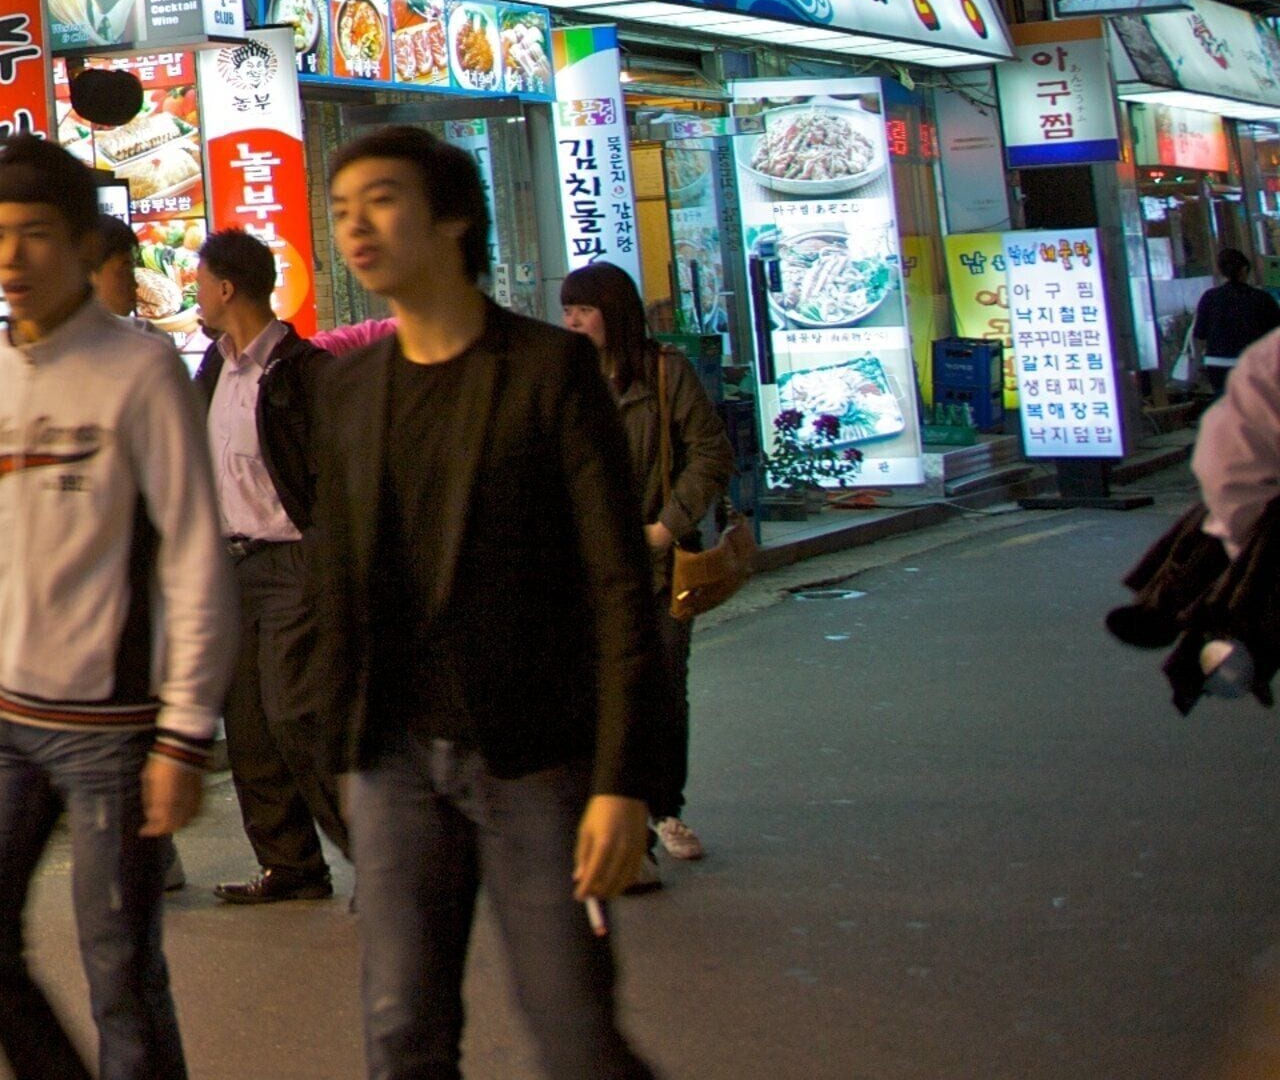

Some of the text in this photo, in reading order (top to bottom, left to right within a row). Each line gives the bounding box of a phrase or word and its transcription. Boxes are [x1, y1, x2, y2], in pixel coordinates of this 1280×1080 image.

[150, 0, 197, 15] Cocktail
[151, 15, 179, 27] Wine
[214, 9, 236, 26] CLUB
[1031, 46, 1074, 140] 아구찜
[607, 136, 627, 184] 묵은지
[558, 138, 608, 265] 김치돌판
[611, 202, 635, 254] 감자탕
[1013, 281, 1095, 301] 아구찜
[1015, 305, 1099, 324] 낙지철판
[1017, 330, 1102, 349] 쭈꾸미철판
[1021, 353, 1105, 372] 갈치조림
[1023, 377, 1108, 397] 생태찌개
[1028, 426, 1114, 445] 낙지덮밥
